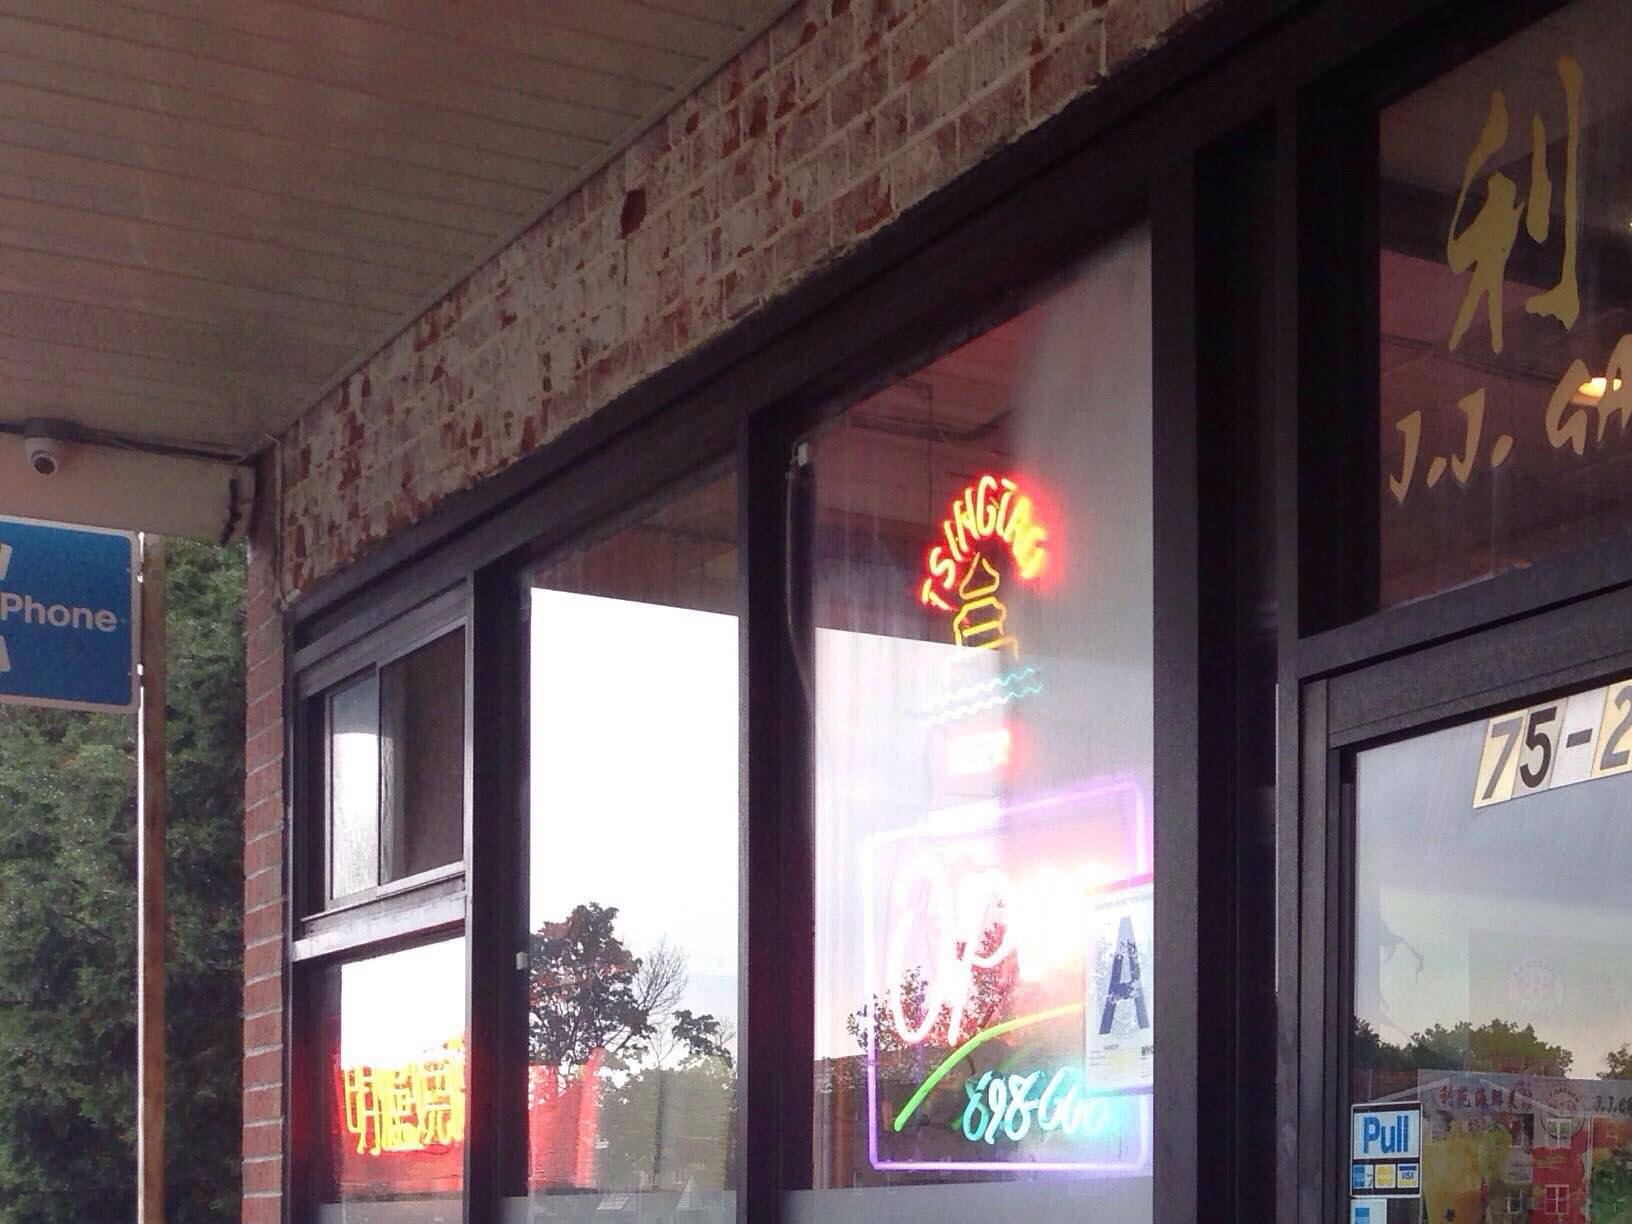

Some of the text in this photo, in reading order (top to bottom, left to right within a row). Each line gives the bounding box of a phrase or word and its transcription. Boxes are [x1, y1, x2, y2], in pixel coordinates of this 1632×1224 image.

[1389, 388, 1514, 504] J.J.
[1098, 916, 1151, 1035] A
[1363, 1115, 1409, 1154] Pull
